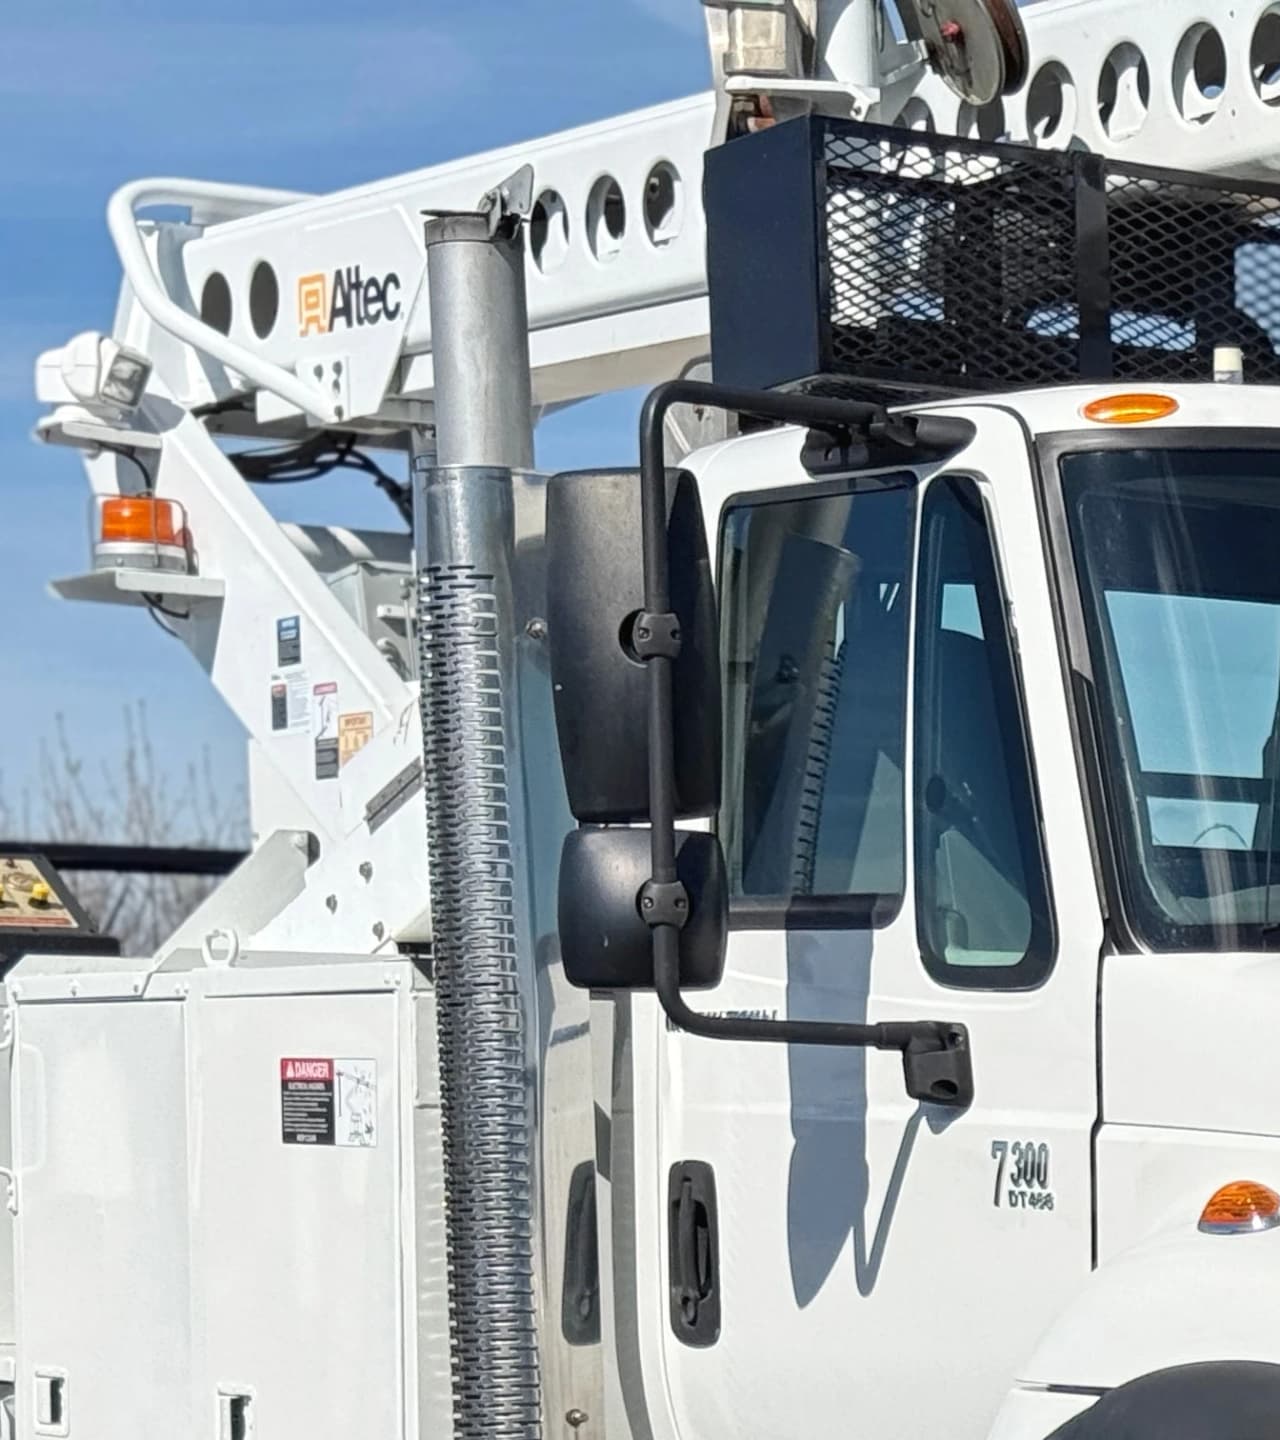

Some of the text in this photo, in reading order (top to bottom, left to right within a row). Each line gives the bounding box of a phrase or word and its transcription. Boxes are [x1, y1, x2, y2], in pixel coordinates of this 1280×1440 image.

[328, 264, 401, 333] Altec
[295, 1061, 329, 1079] DANGER
[991, 1140, 1050, 1208] 7300
